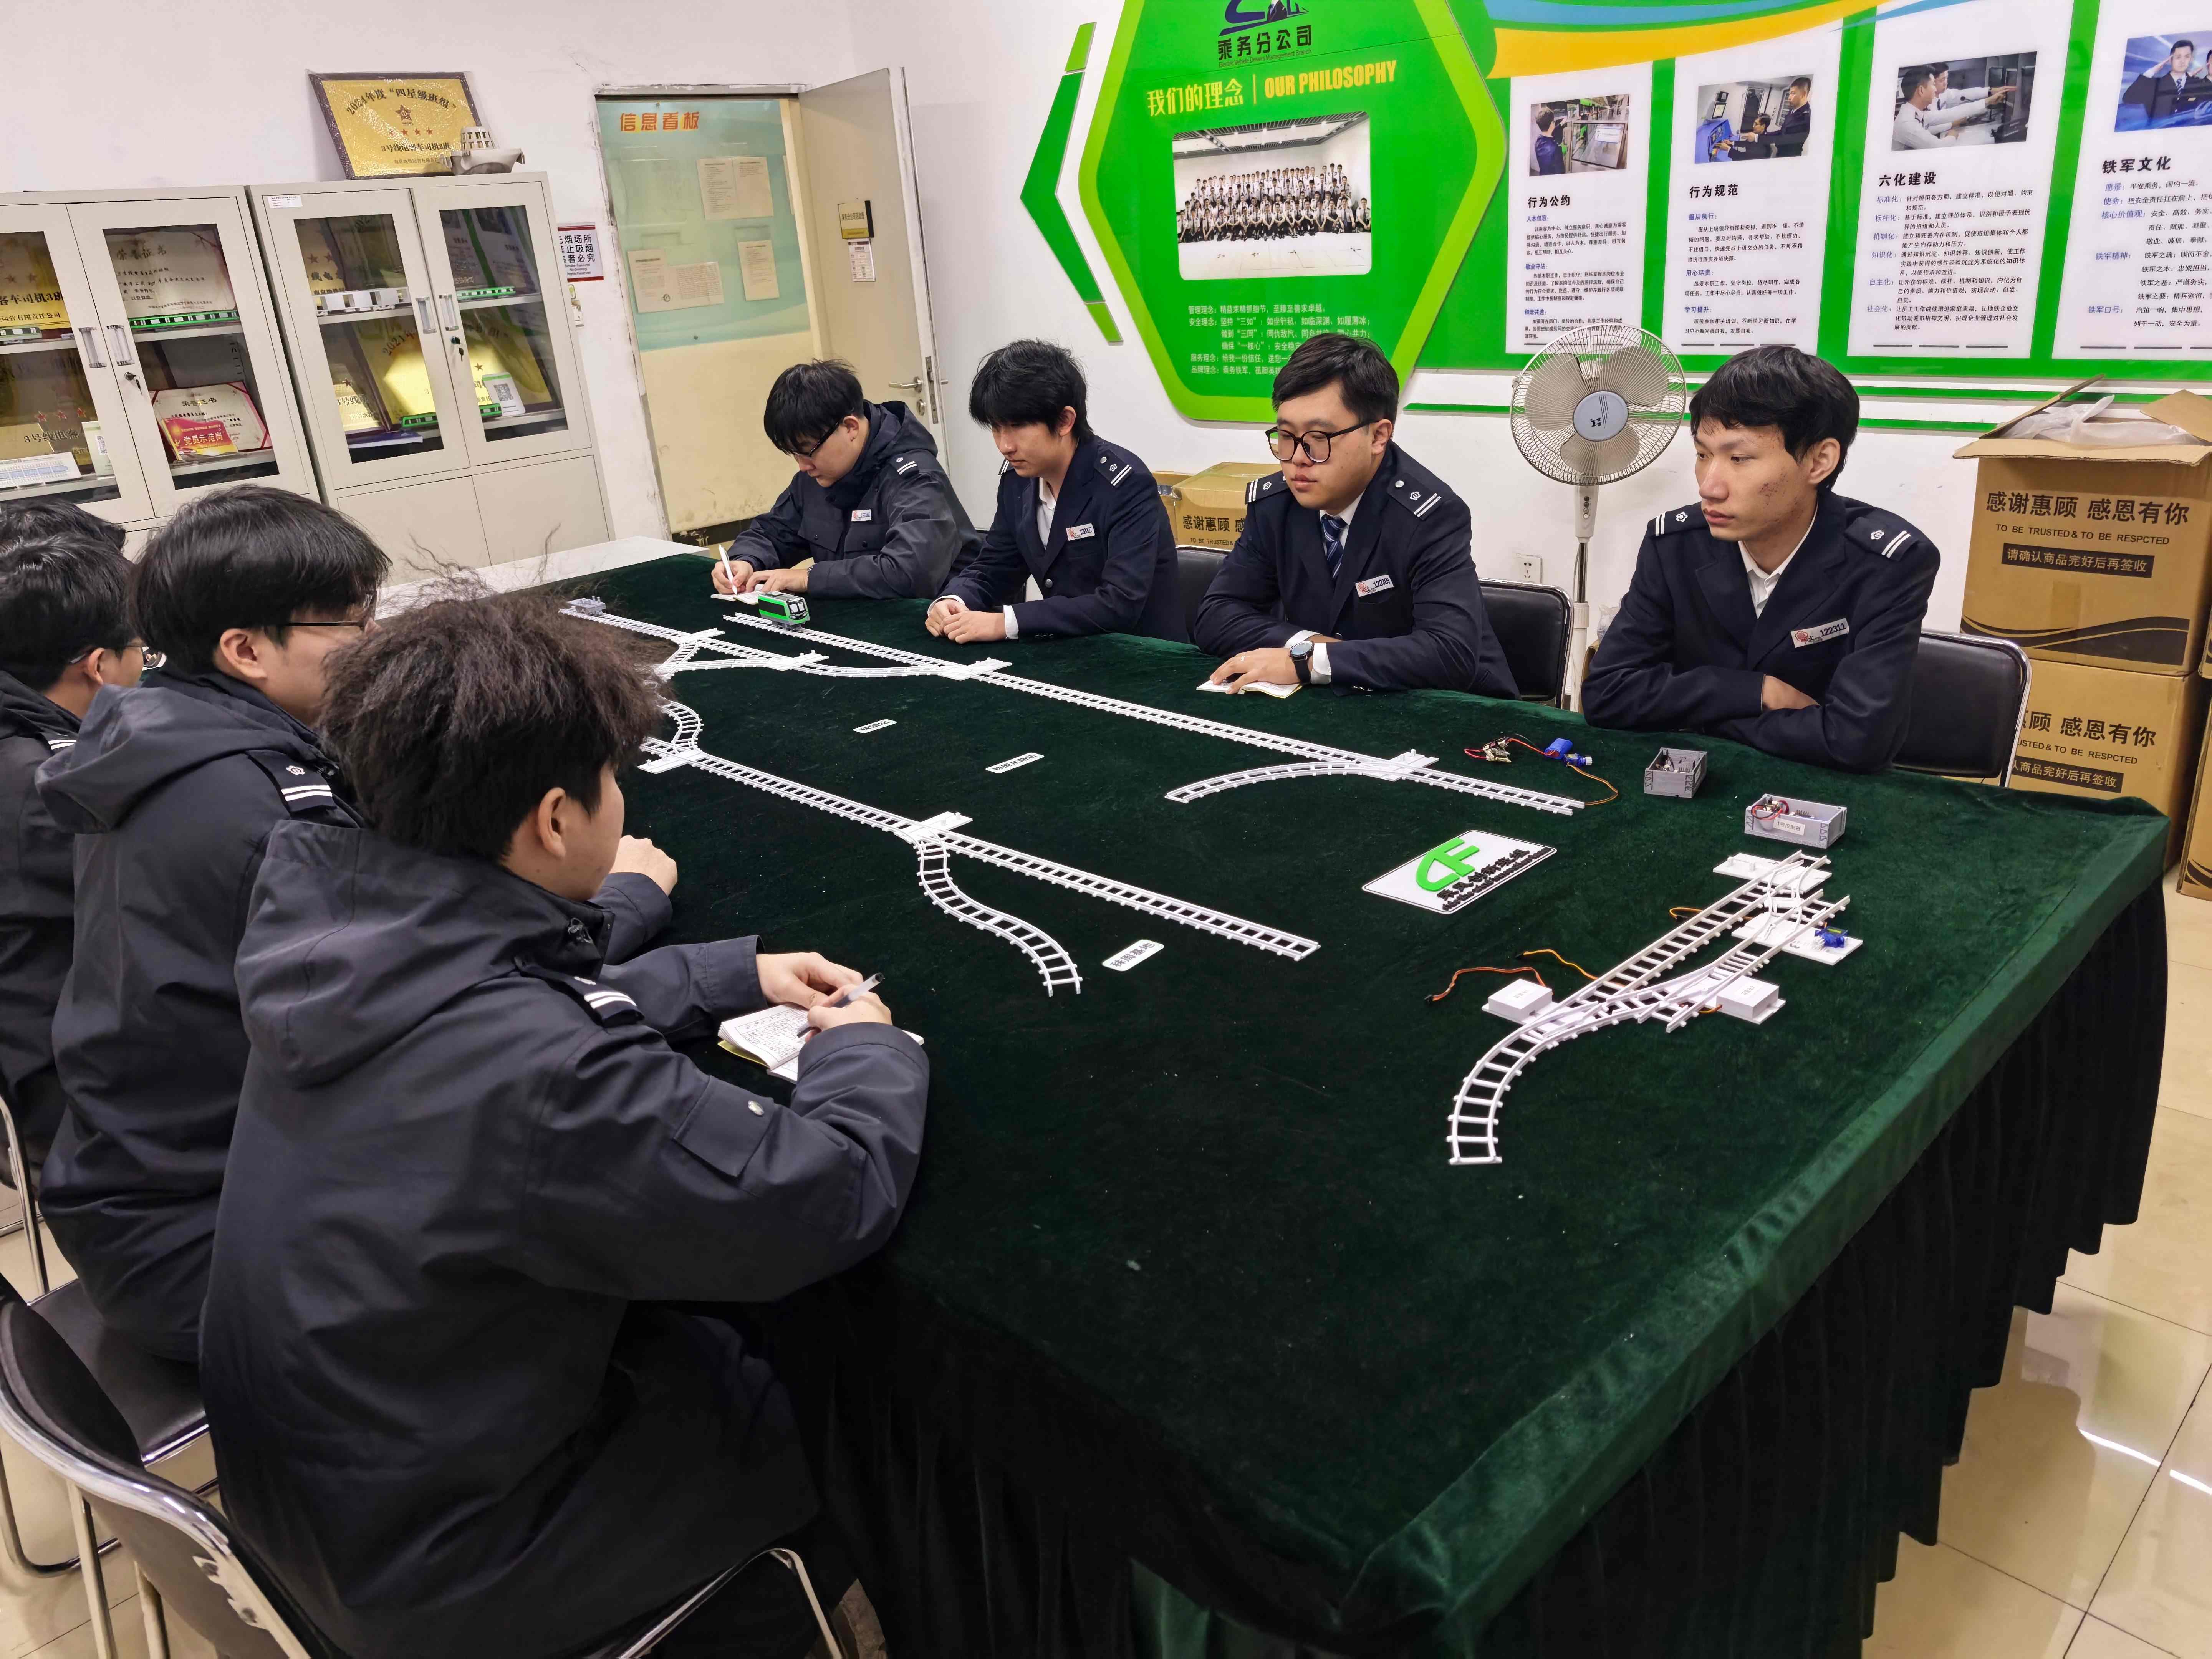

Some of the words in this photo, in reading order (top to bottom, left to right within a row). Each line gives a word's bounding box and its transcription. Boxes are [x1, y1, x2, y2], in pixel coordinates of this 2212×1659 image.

[1218, 25, 1311, 60] 乘务分公司
[1265, 77, 1295, 98] OUR
[1299, 60, 1397, 94] PHILOSOPHY
[1147, 78, 1243, 117] 我们的理念
[620, 111, 699, 131] 信息看板
[2102, 156, 2171, 174] 铁军文化
[1879, 172, 1937, 187] 六化建设
[1689, 184, 1738, 198] 行为规范
[1528, 195, 1570, 208] 行为公约
[2101, 210, 2145, 219] 核心价值观：
[184, 432, 223, 445] 党员示范岗
[1986, 491, 2078, 518] 感谢惠顾
[2087, 498, 2189, 525] 感恩有你
[1183, 515, 1230, 532] 感谢惠顾
[1996, 524, 2007, 532] TO
[2028, 527, 2070, 538] TRUSTED
[2081, 531, 2094, 540] TO
[2099, 533, 2111, 541] BE
[2117, 534, 2170, 545] RESPCTED
[2007, 548, 2147, 572] 请确认商品完好后再签收
[1373, 578, 1390, 588] 122309
[1819, 623, 1847, 637] 122311
[2021, 710, 2052, 732] 顾
[2060, 717, 2156, 747] 感恩有你
[2055, 745, 2066, 753] TO
[2071, 748, 2083, 756] BE
[2088, 751, 2138, 764] RESPCTED
[1110, 943, 1156, 967] 秣周基地
